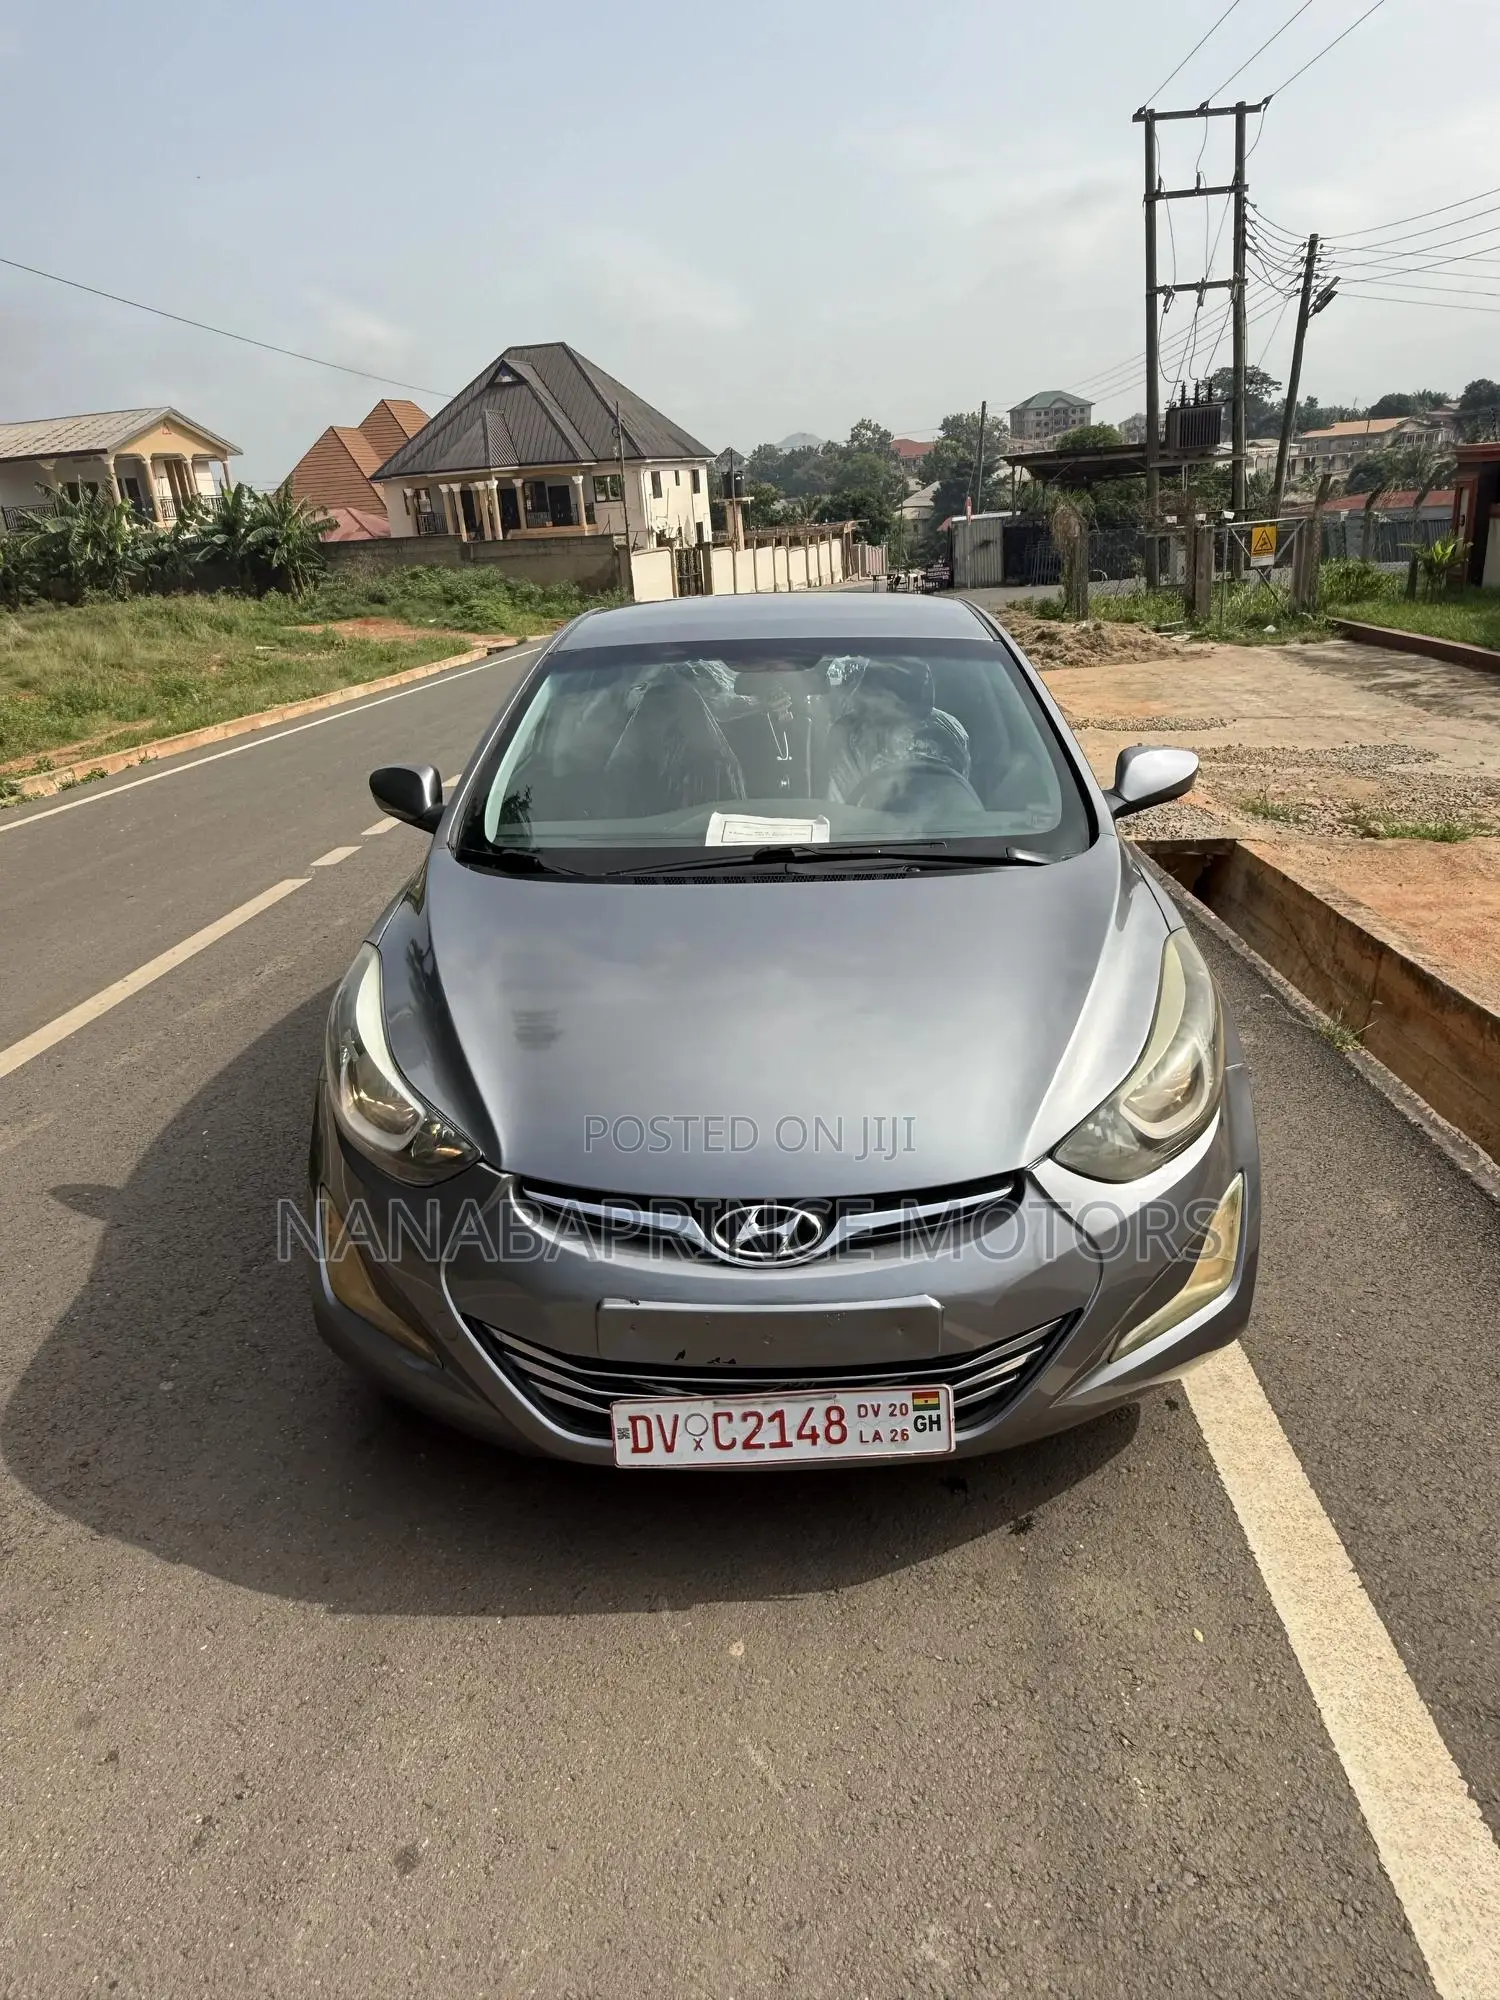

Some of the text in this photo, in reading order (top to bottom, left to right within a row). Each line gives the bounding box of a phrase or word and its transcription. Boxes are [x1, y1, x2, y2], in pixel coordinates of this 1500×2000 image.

[857, 1402, 909, 1418] DV 20
[628, 1405, 848, 1454] DV C2148
[913, 1414, 942, 1433] GH
[859, 1428, 910, 1443] LA 26
